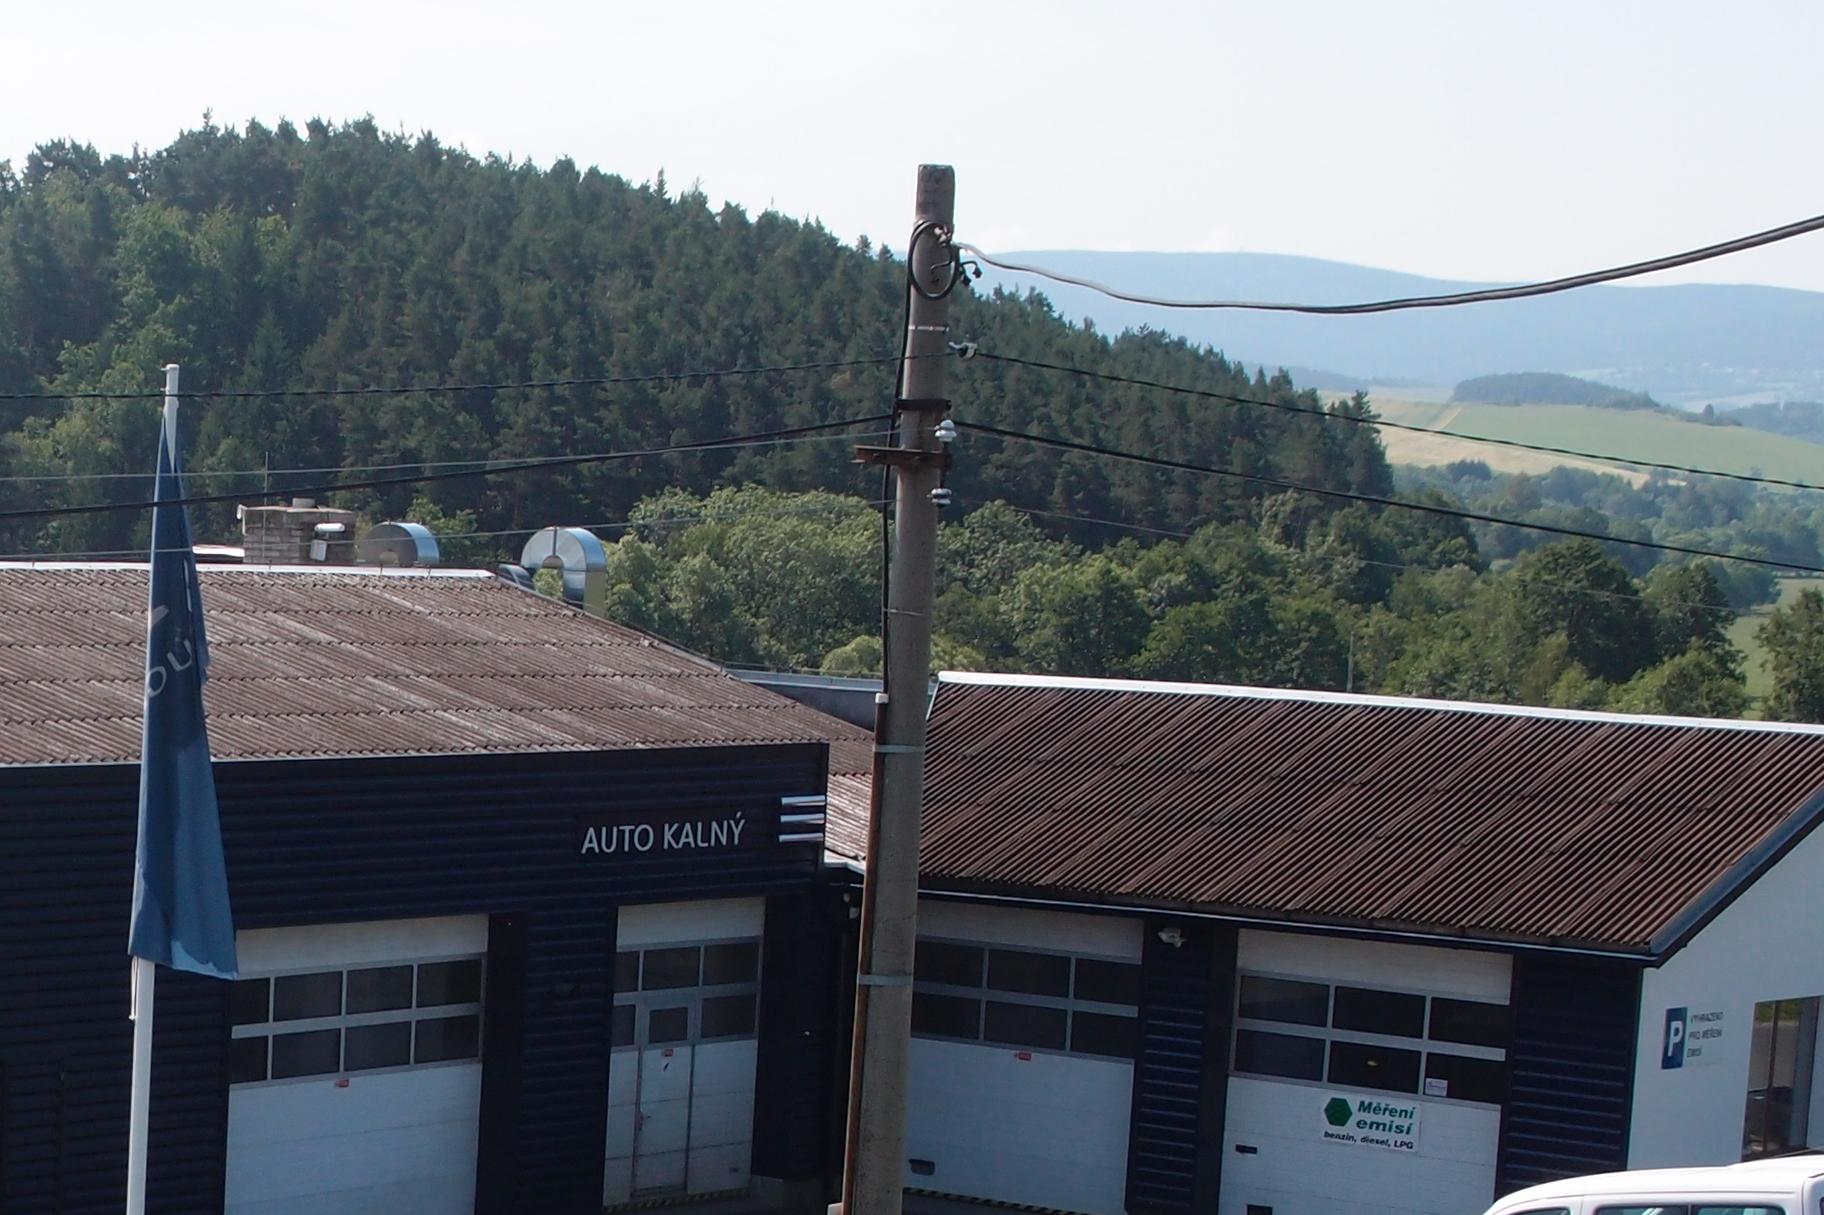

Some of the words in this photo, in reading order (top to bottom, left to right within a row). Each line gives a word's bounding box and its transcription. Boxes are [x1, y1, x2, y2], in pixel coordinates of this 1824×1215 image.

[580, 823, 655, 855] AUTO
[663, 811, 746, 850] KALNÝ
[1667, 1020, 1683, 1057] P
[1357, 1100, 1416, 1119] Měření
[1356, 1119, 1414, 1135] emisí
[1360, 1135, 1391, 1148] diesel,
[1394, 1140, 1414, 1150] LPG
